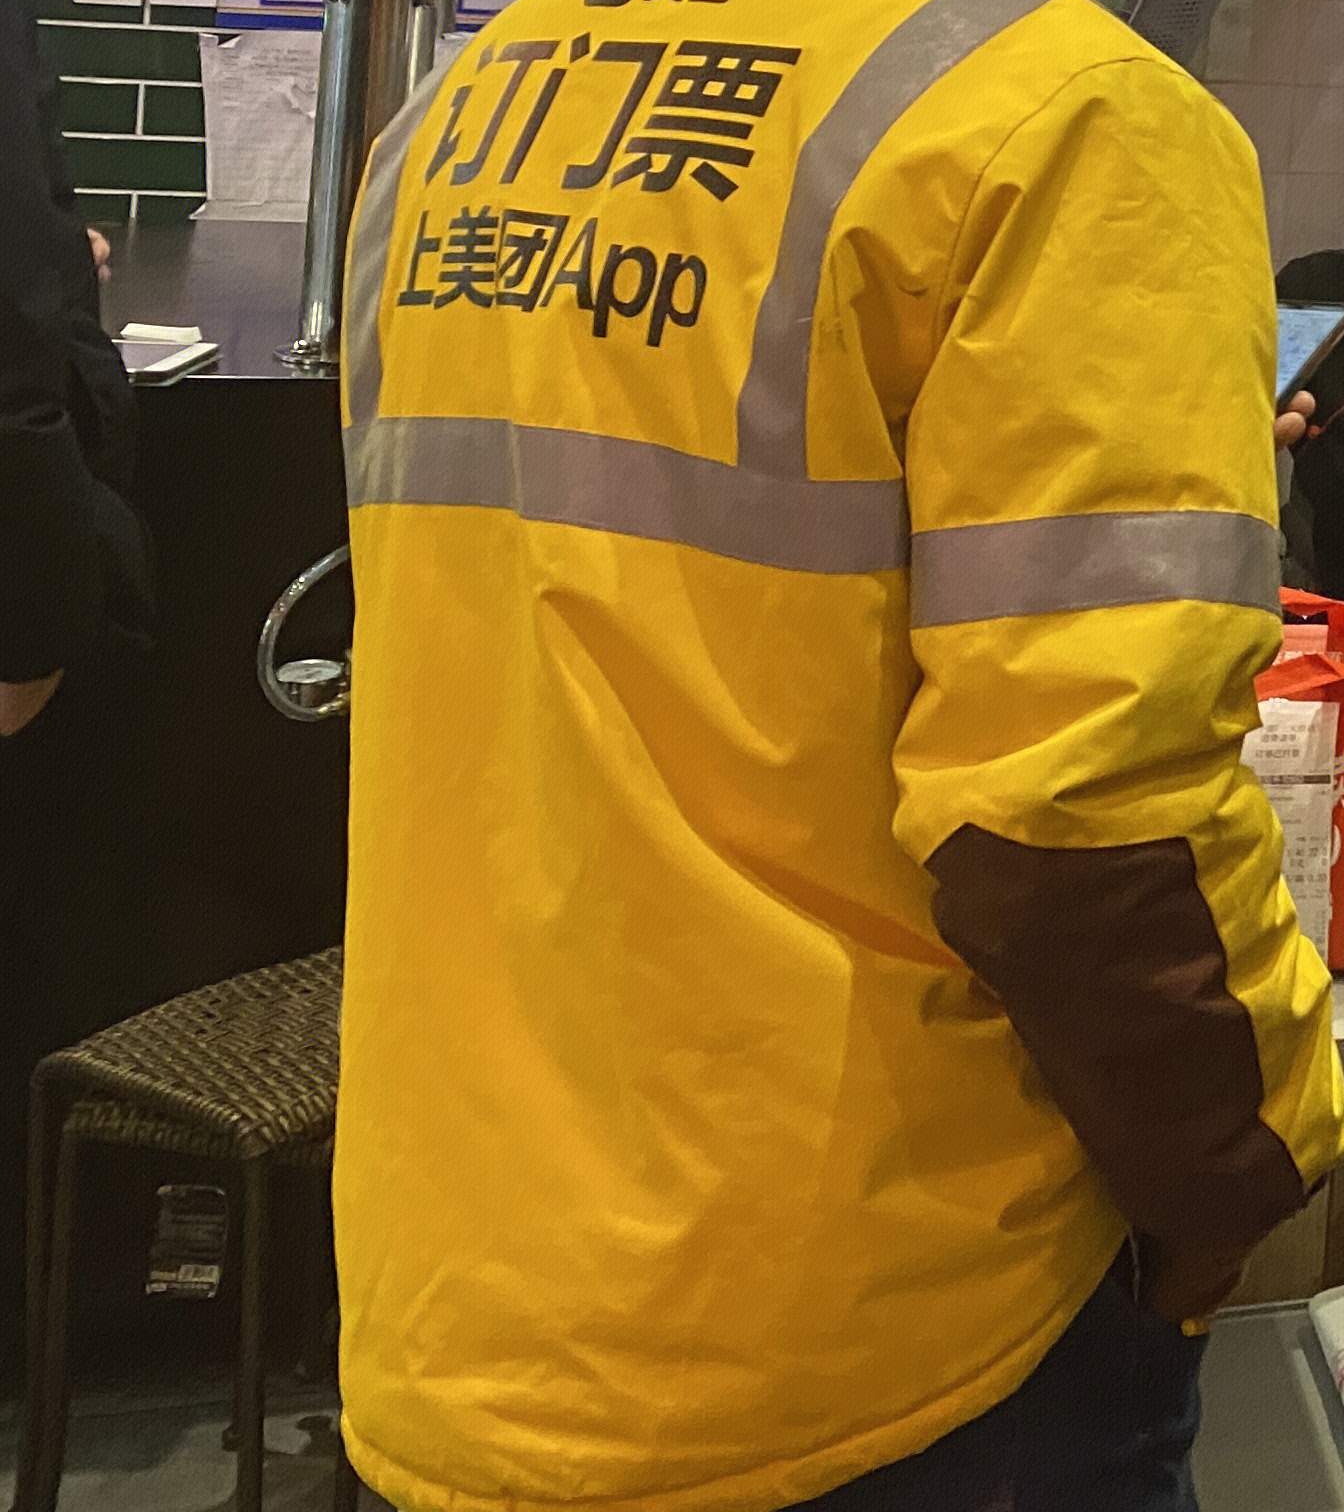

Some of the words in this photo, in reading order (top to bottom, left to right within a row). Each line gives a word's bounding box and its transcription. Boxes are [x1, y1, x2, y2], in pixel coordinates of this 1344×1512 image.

[423, 30, 803, 204] 订门票
[394, 203, 709, 349] 上美团App
